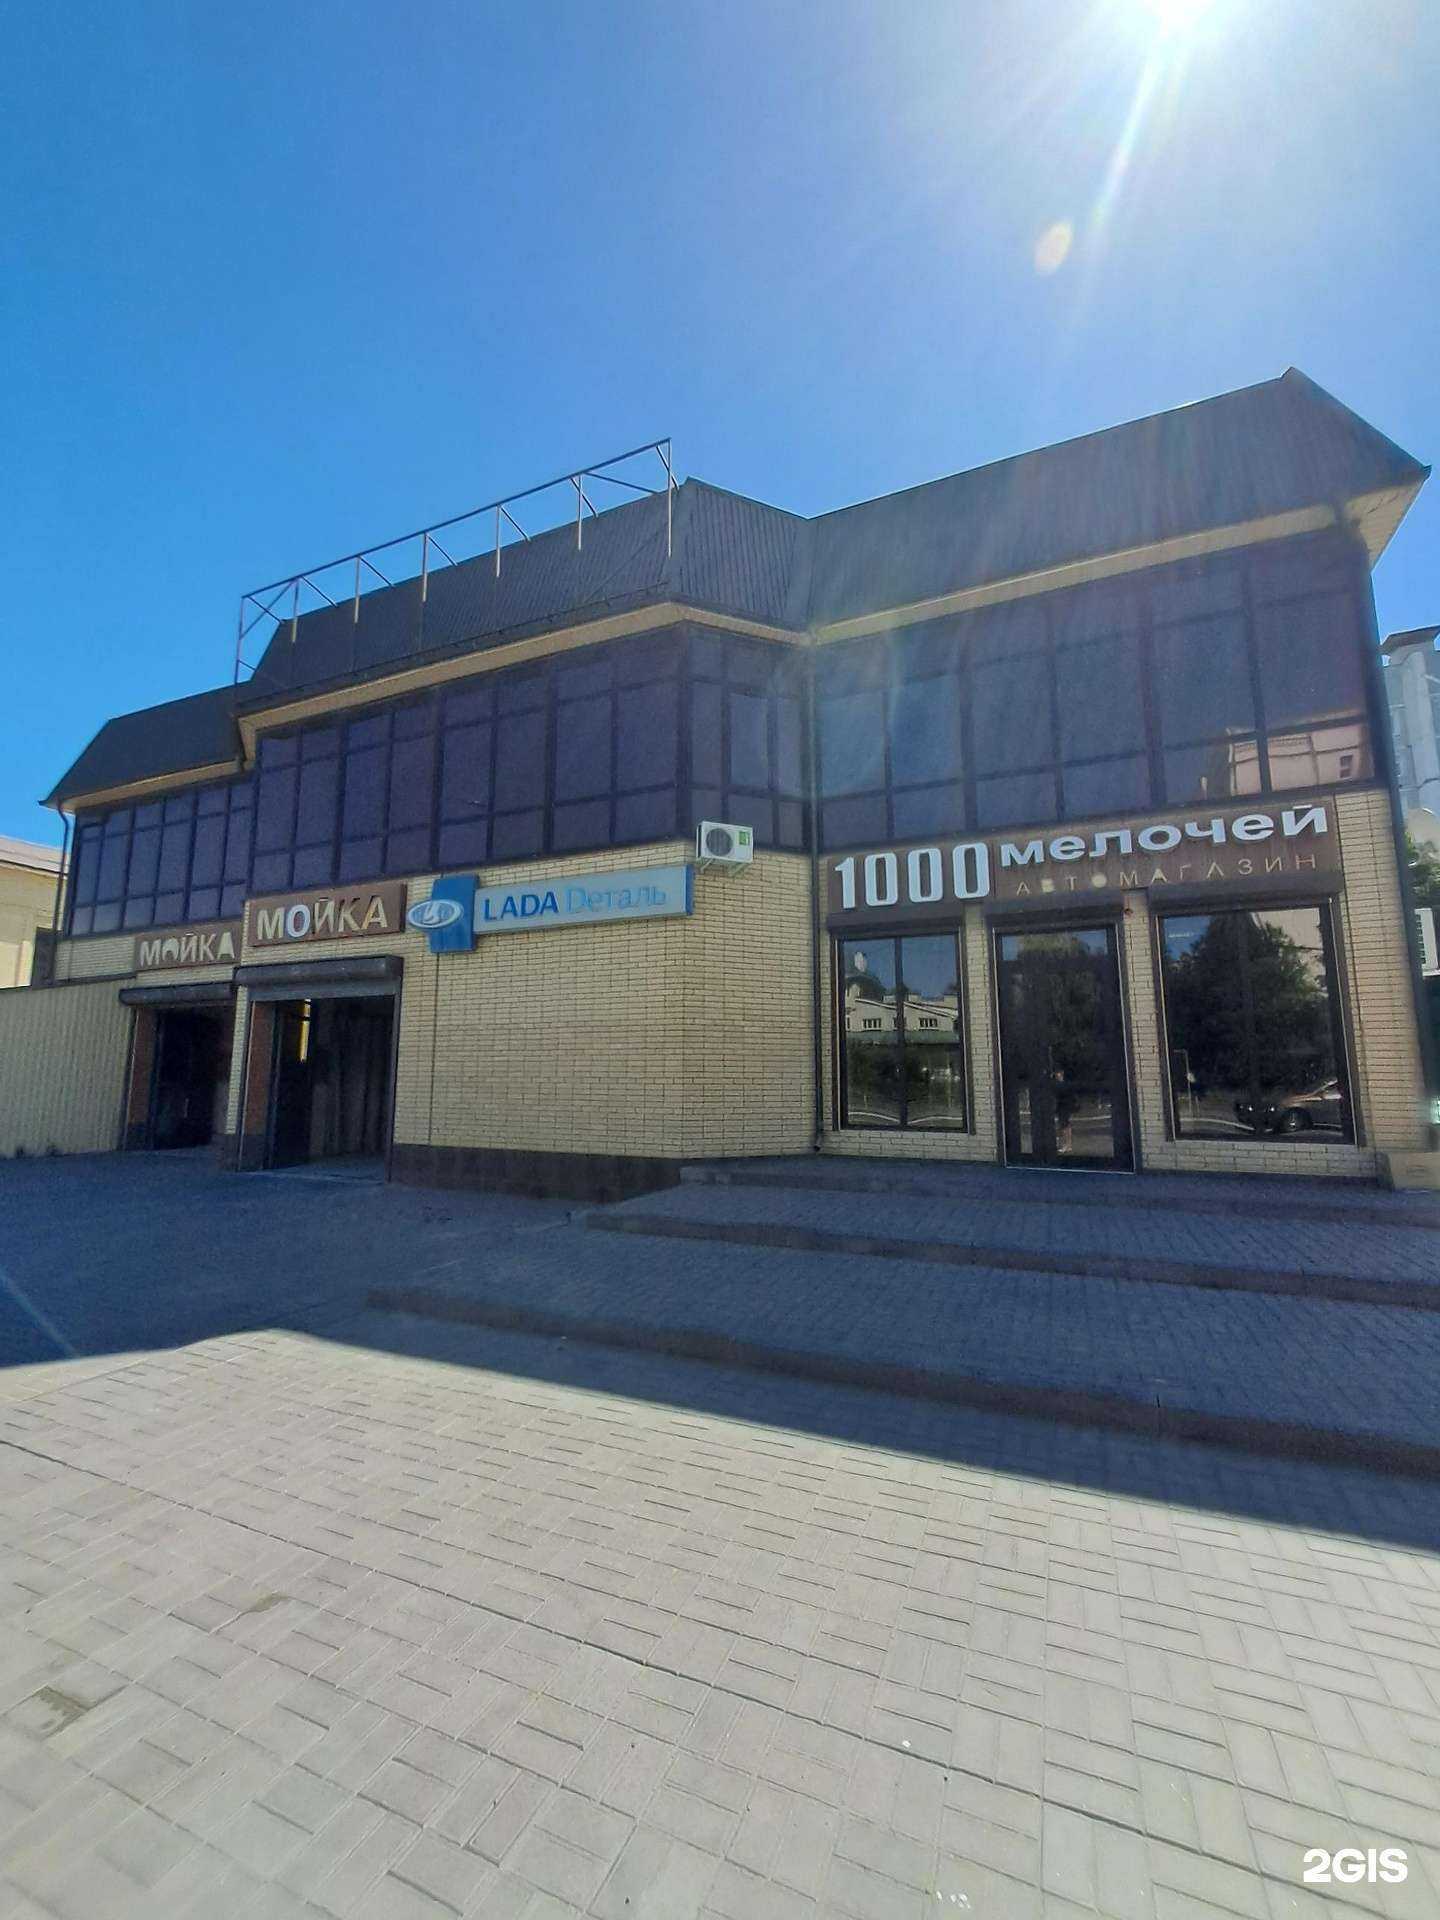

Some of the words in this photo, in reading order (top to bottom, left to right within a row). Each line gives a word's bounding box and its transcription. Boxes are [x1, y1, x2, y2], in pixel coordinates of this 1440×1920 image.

[834, 842, 990, 909] 1000
[1001, 805, 1327, 866] мелочей
[257, 895, 388, 941] МОЙКА
[484, 891, 559, 921] LADA
[139, 931, 235, 967] МОЙКА
